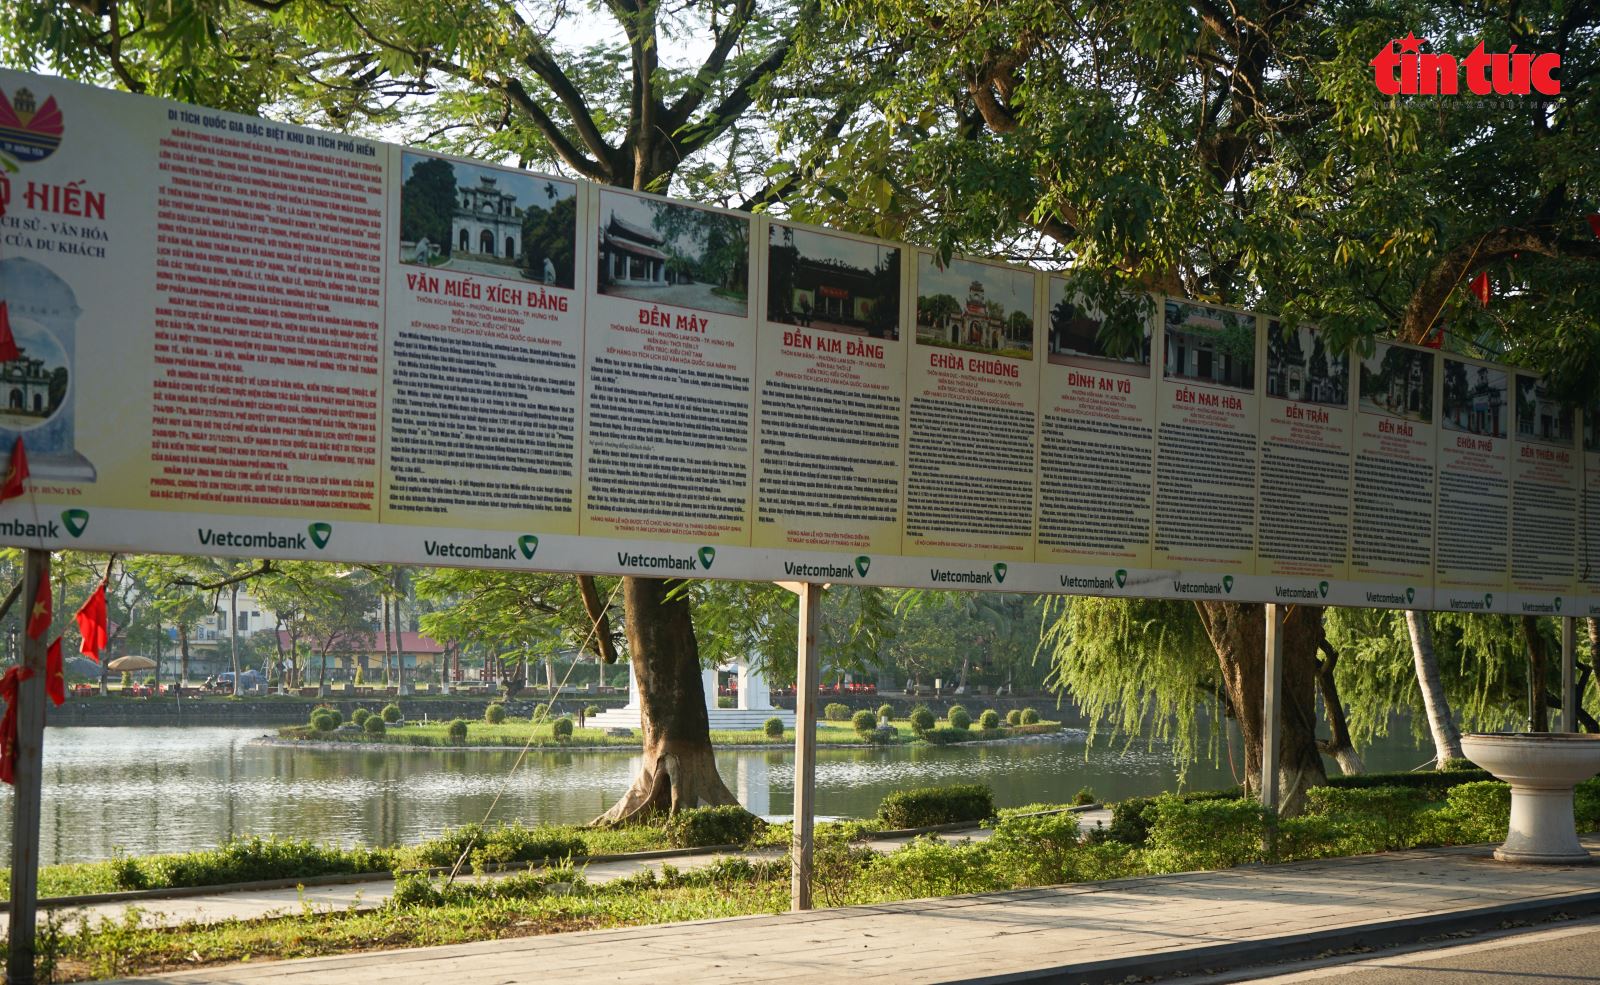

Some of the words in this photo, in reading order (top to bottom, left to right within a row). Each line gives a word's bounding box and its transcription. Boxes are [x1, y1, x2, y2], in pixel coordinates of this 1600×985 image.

[167, 109, 177, 121] DI
[180, 109, 200, 125] TÍCH
[202, 113, 226, 130] QUỐC
[228, 120, 244, 133] GIA
[245, 121, 263, 139] ĐẶC
[265, 125, 284, 143] BIỆT
[286, 131, 303, 144] KHU
[305, 134, 314, 146] DI
[317, 134, 335, 150] TÍCH
[337, 137, 354, 153] PHỐ
[356, 141, 376, 158] HIẾN
[23, 179, 106, 220] HIẾN
[23, 217, 40, 231] SỬ
[51, 222, 78, 237] VĂN
[81, 226, 109, 242] HÓA
[5, 232, 33, 248] CỦA
[36, 239, 55, 251] DU
[58, 242, 106, 258] KHÁCH
[406, 272, 439, 293] VĂN
[444, 277, 481, 300] MIẾU
[486, 284, 522, 305] XÍCH
[527, 287, 568, 312] ĐẰNG
[638, 305, 671, 329] ĐỀN
[676, 312, 709, 334] MÂY
[783, 328, 812, 350] ĐỀN
[817, 336, 842, 354] KIM
[846, 337, 884, 359] ĐẰNG
[930, 353, 965, 370] CHÙA
[968, 358, 1019, 378] CHUÔNG
[1067, 370, 1095, 389] ĐÌNH
[1098, 377, 1113, 391] AN
[1176, 386, 1195, 402] ĐỀN
[1198, 393, 1219, 408] NAM
[1222, 394, 1242, 410] HÒA
[1286, 404, 1304, 419] ĐỀN
[198, 528, 306, 550] Vietcombank
[424, 540, 517, 560] Vietcombank
[617, 551, 696, 571] Vietcombank
[784, 560, 854, 579] Vietcombank
[930, 568, 992, 584] Vietcombank
[1060, 575, 1114, 589] Vietcombank
[1174, 581, 1222, 594] Vietcombank
[1275, 585, 1318, 599] Vietcombank
[1366, 591, 1405, 604] Vietcombank
